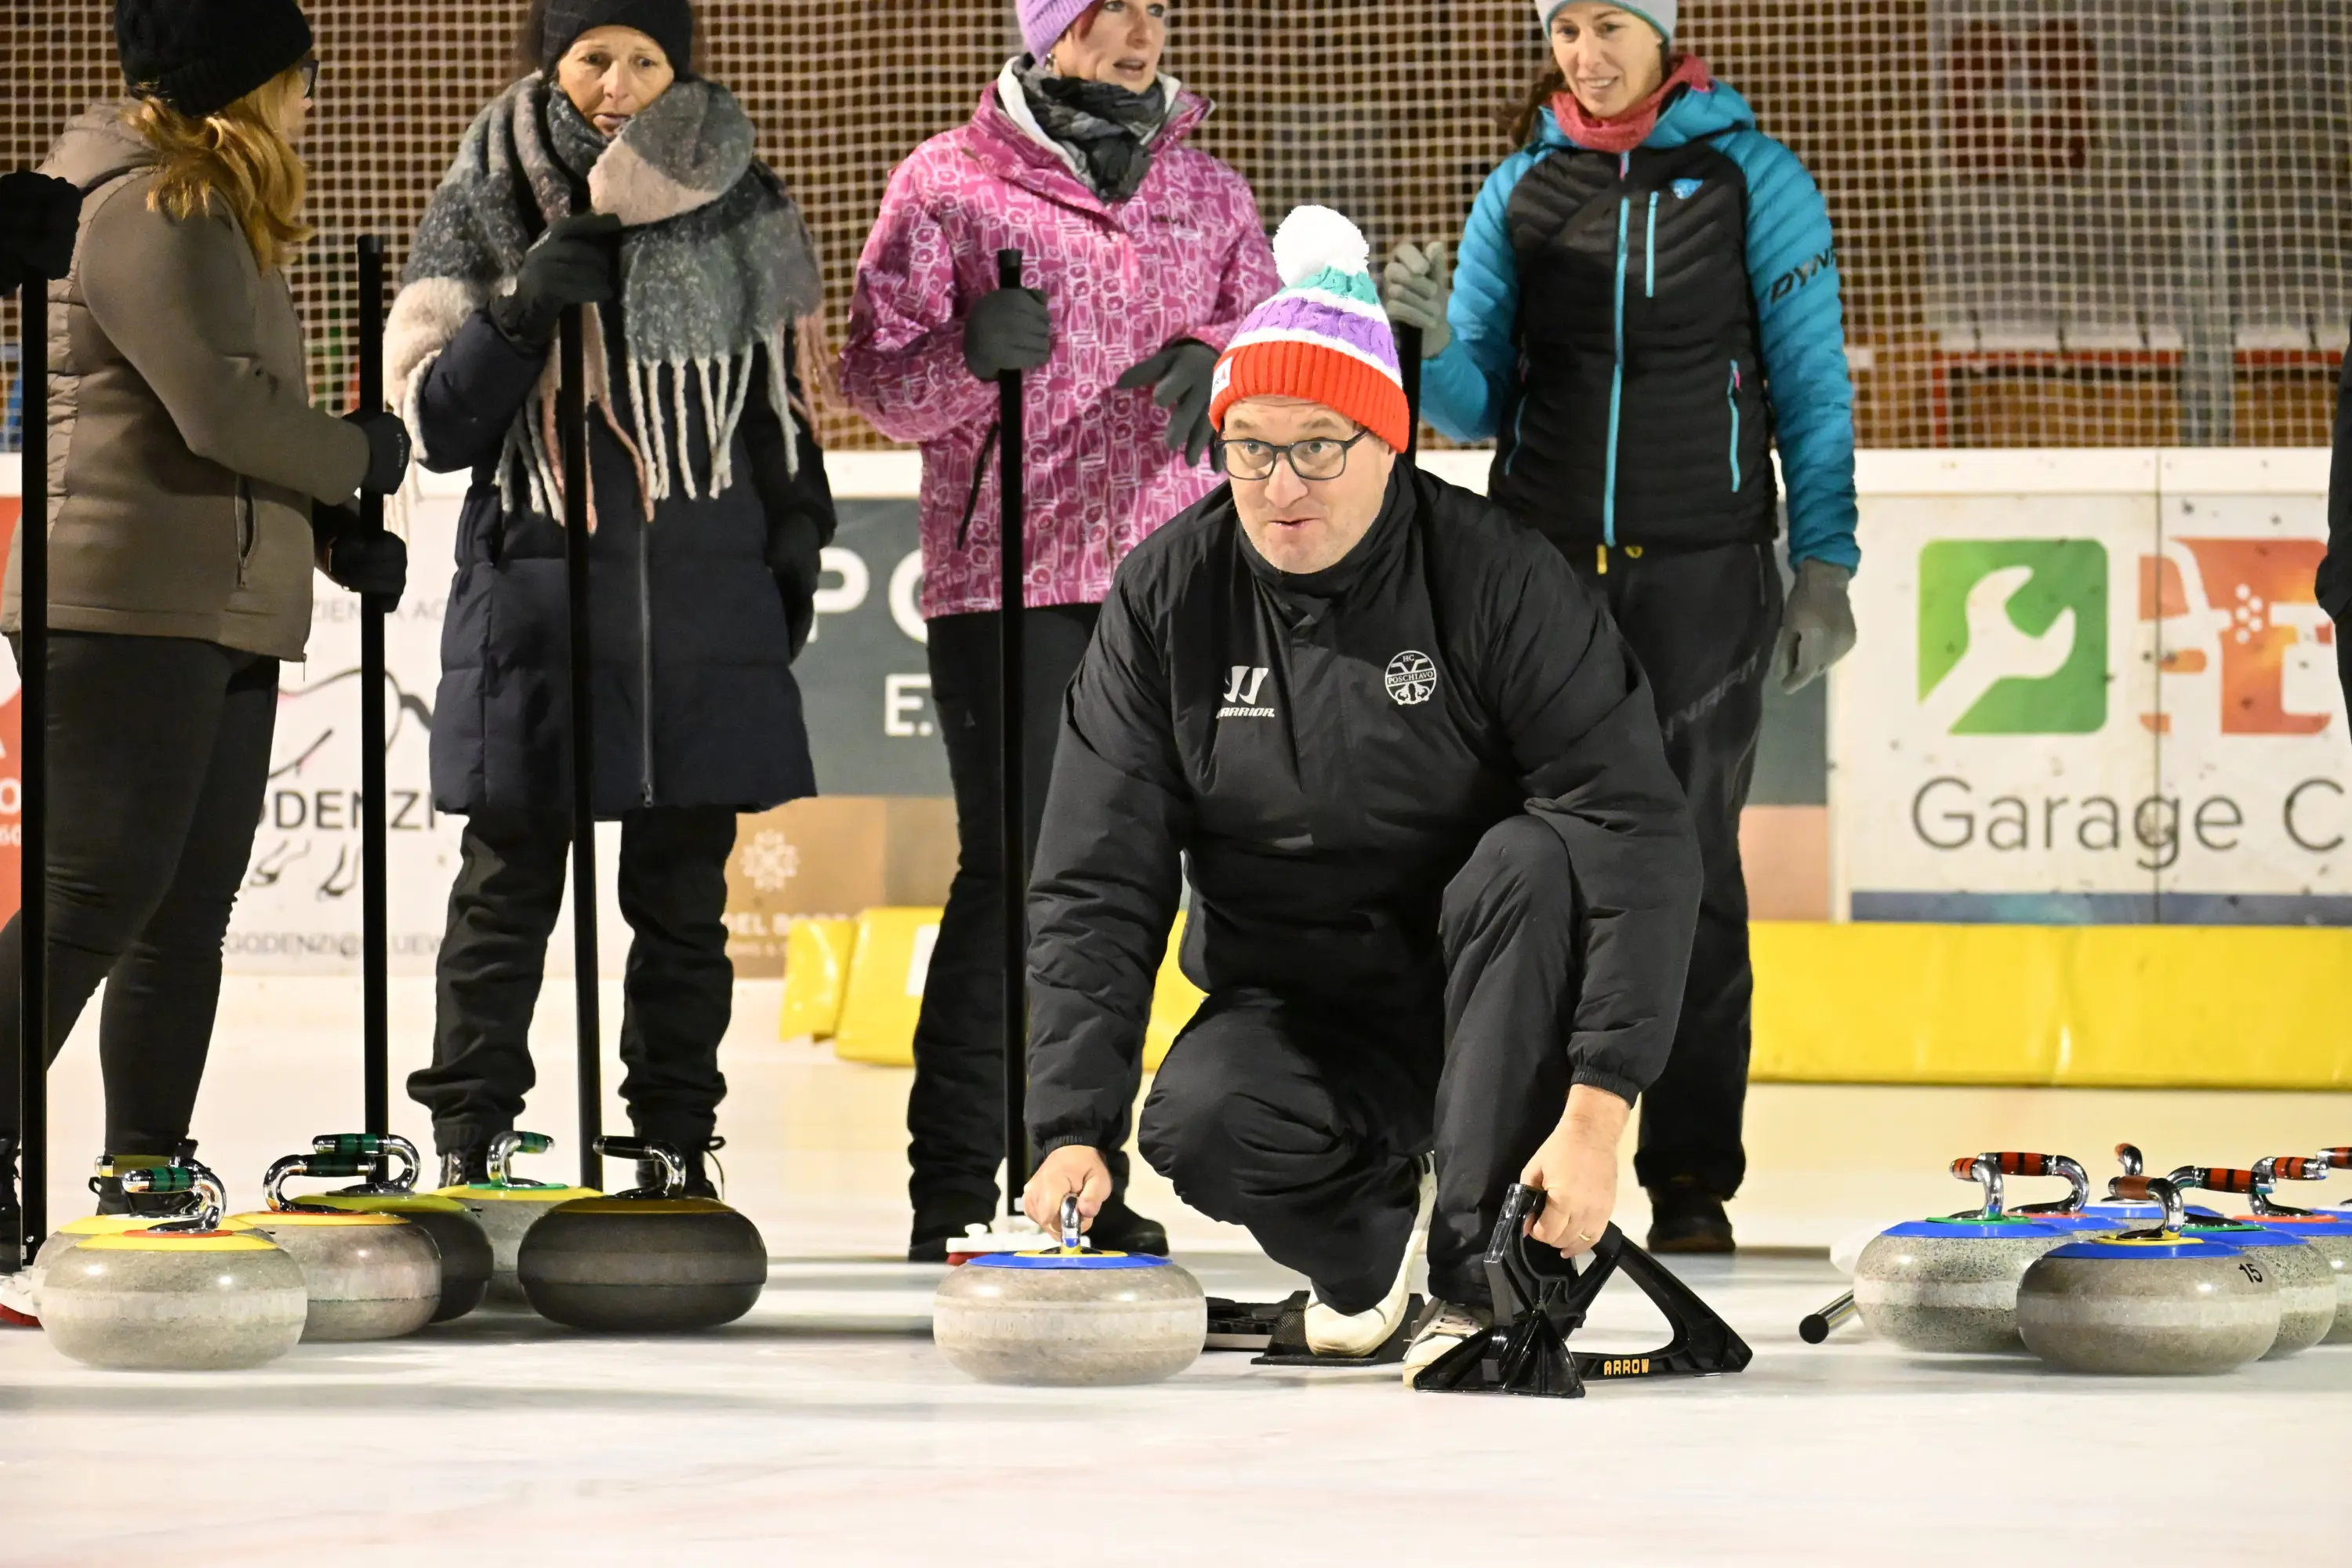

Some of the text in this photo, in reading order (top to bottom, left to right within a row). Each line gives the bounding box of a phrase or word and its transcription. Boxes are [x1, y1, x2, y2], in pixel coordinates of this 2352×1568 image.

[1388, 671, 1434, 684] POSCHIAVO
[260, 790, 436, 829] DEZI
[1911, 776, 2244, 871] Garage
[2238, 1263, 2263, 1283] 15
[1603, 1358, 1650, 1376] ARROW
